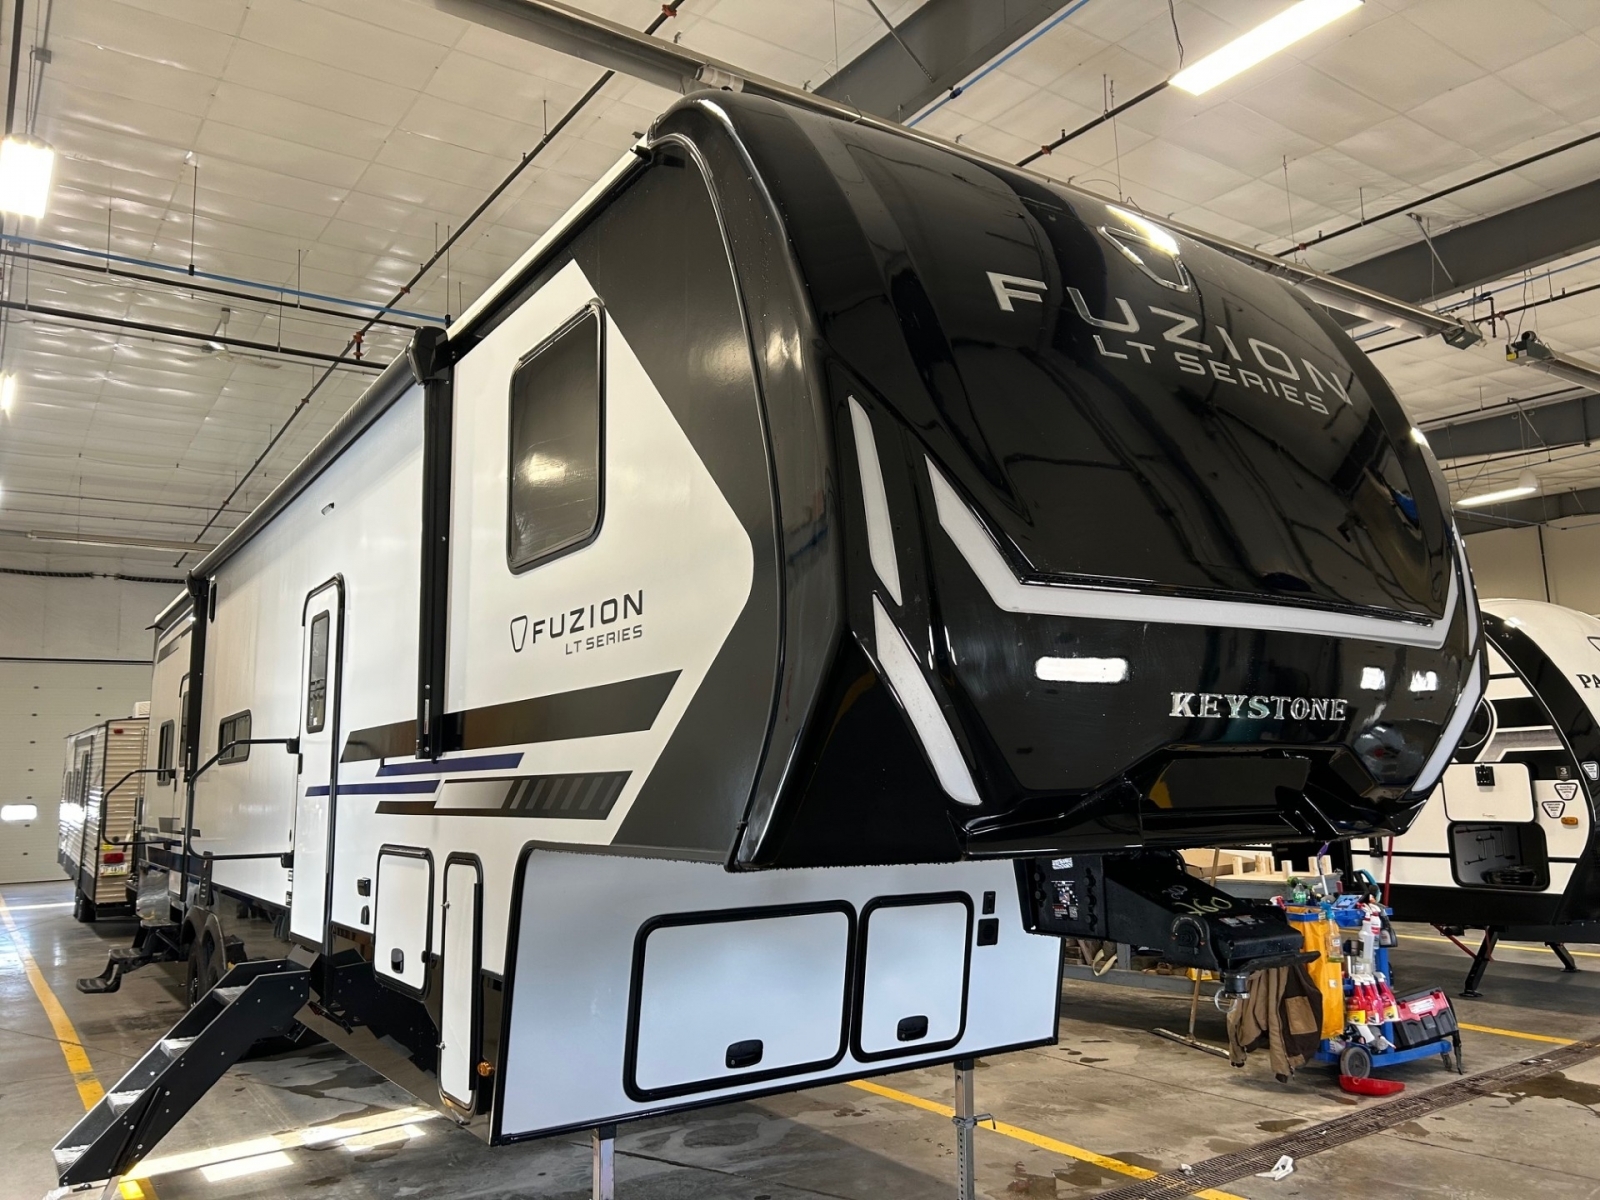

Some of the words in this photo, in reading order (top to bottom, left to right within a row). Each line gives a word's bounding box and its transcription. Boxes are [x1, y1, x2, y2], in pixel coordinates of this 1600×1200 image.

[986, 271, 1352, 406] FUZION
[1094, 334, 1156, 364] LT
[1174, 352, 1329, 414] SERIES
[532, 590, 643, 644] FUZION
[565, 640, 582, 655] LT
[586, 625, 642, 650] SERIES
[1169, 692, 1348, 721] KEYSTONE
